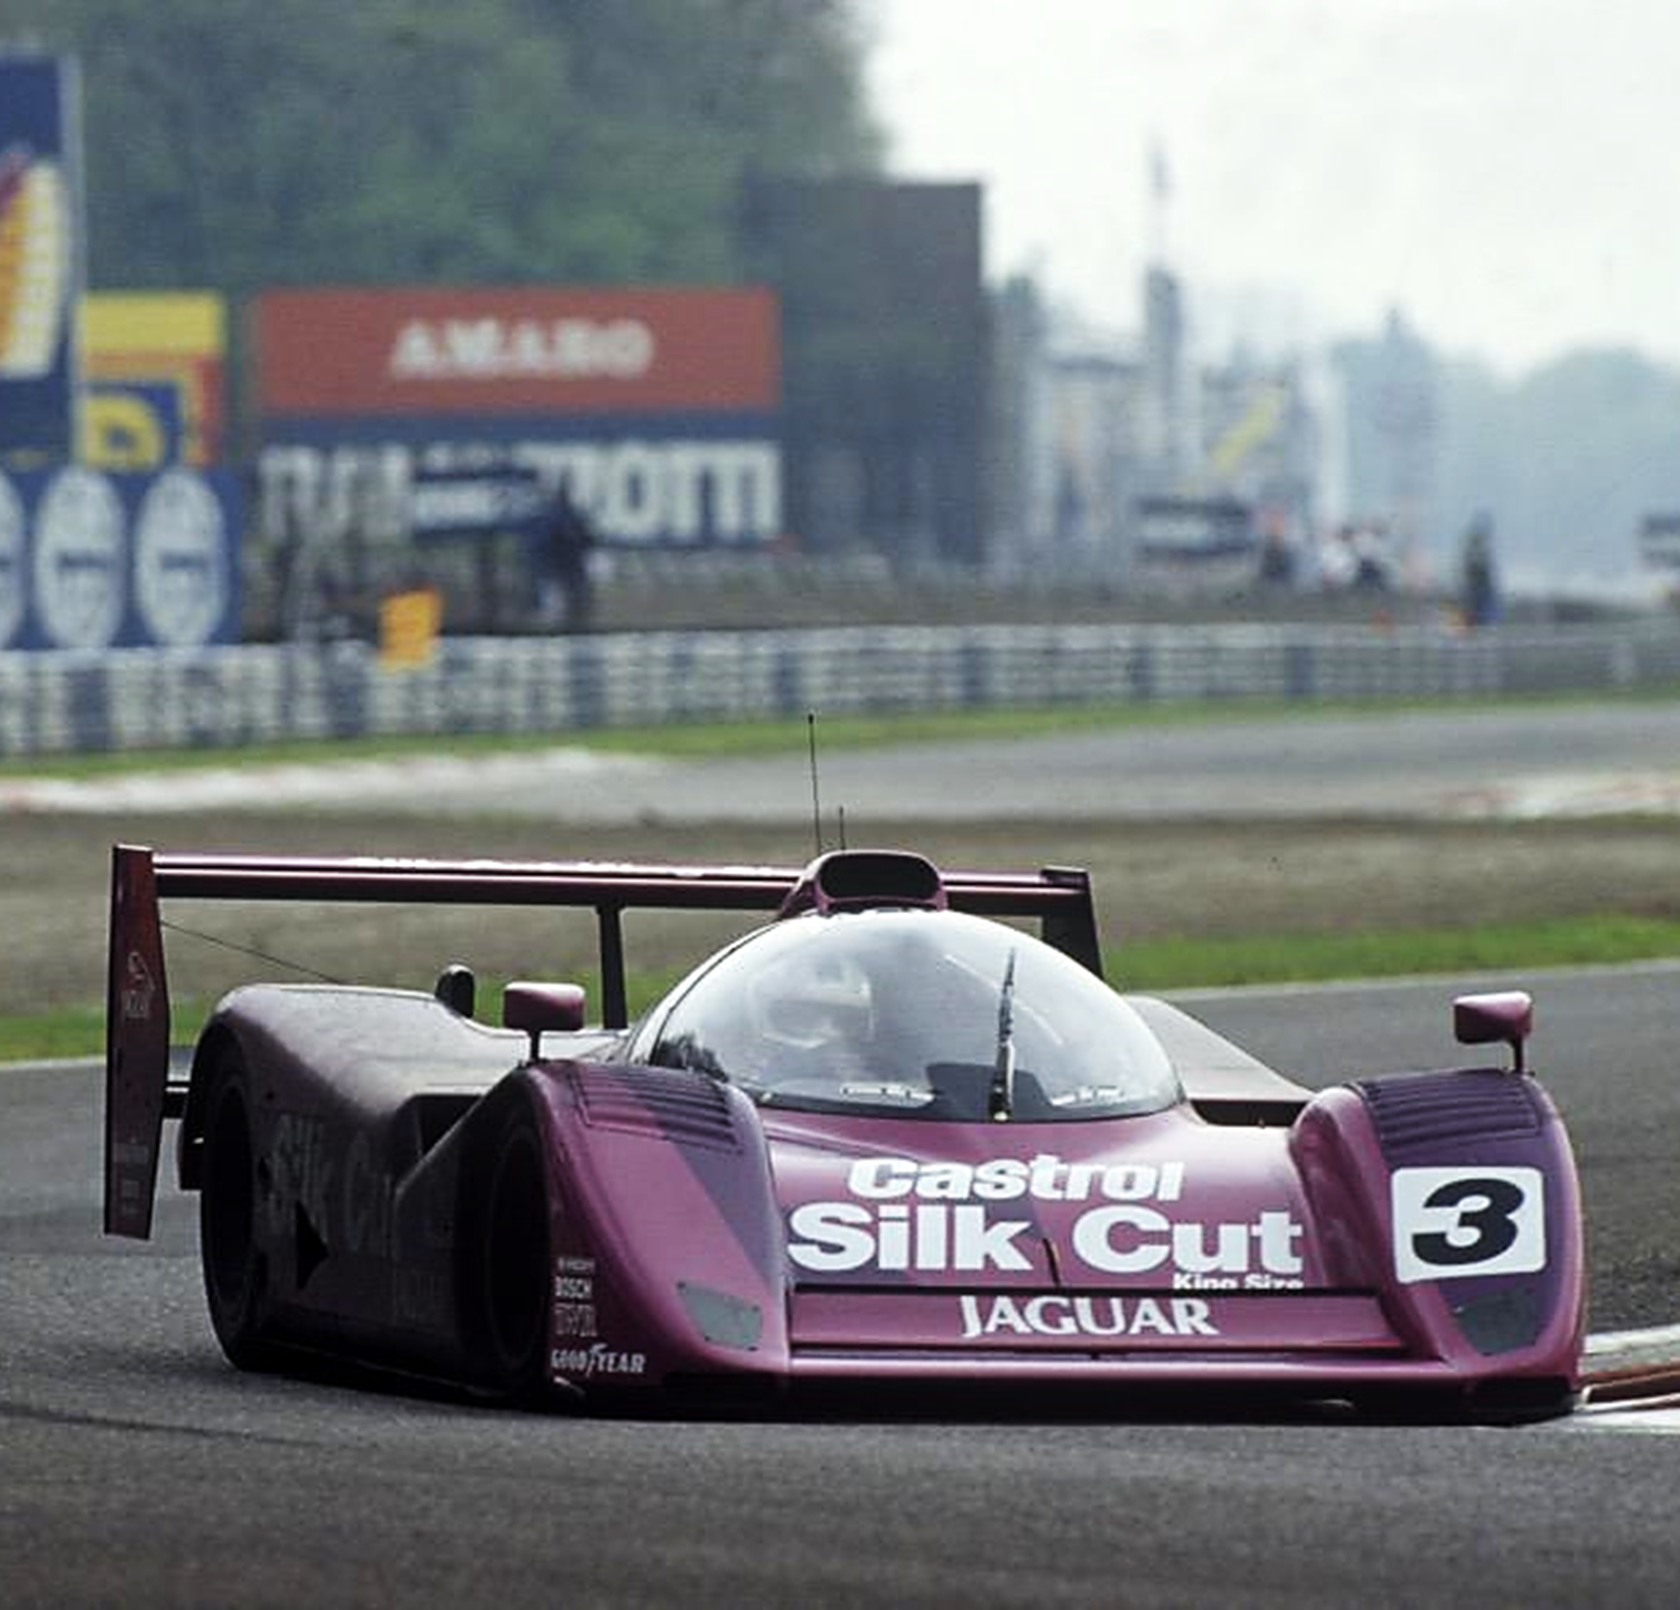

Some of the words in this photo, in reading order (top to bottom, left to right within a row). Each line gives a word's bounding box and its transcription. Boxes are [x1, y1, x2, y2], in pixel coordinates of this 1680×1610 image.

[391, 317, 655, 380] AMARO
[848, 1154, 1185, 1201] Castrol
[787, 1202, 1033, 1272] Silk
[1072, 1204, 1303, 1274] Cut
[1411, 1178, 1525, 1266] 3
[960, 1295, 1220, 1339] JAGUAR
[551, 1343, 647, 1377] GOODYEAR
